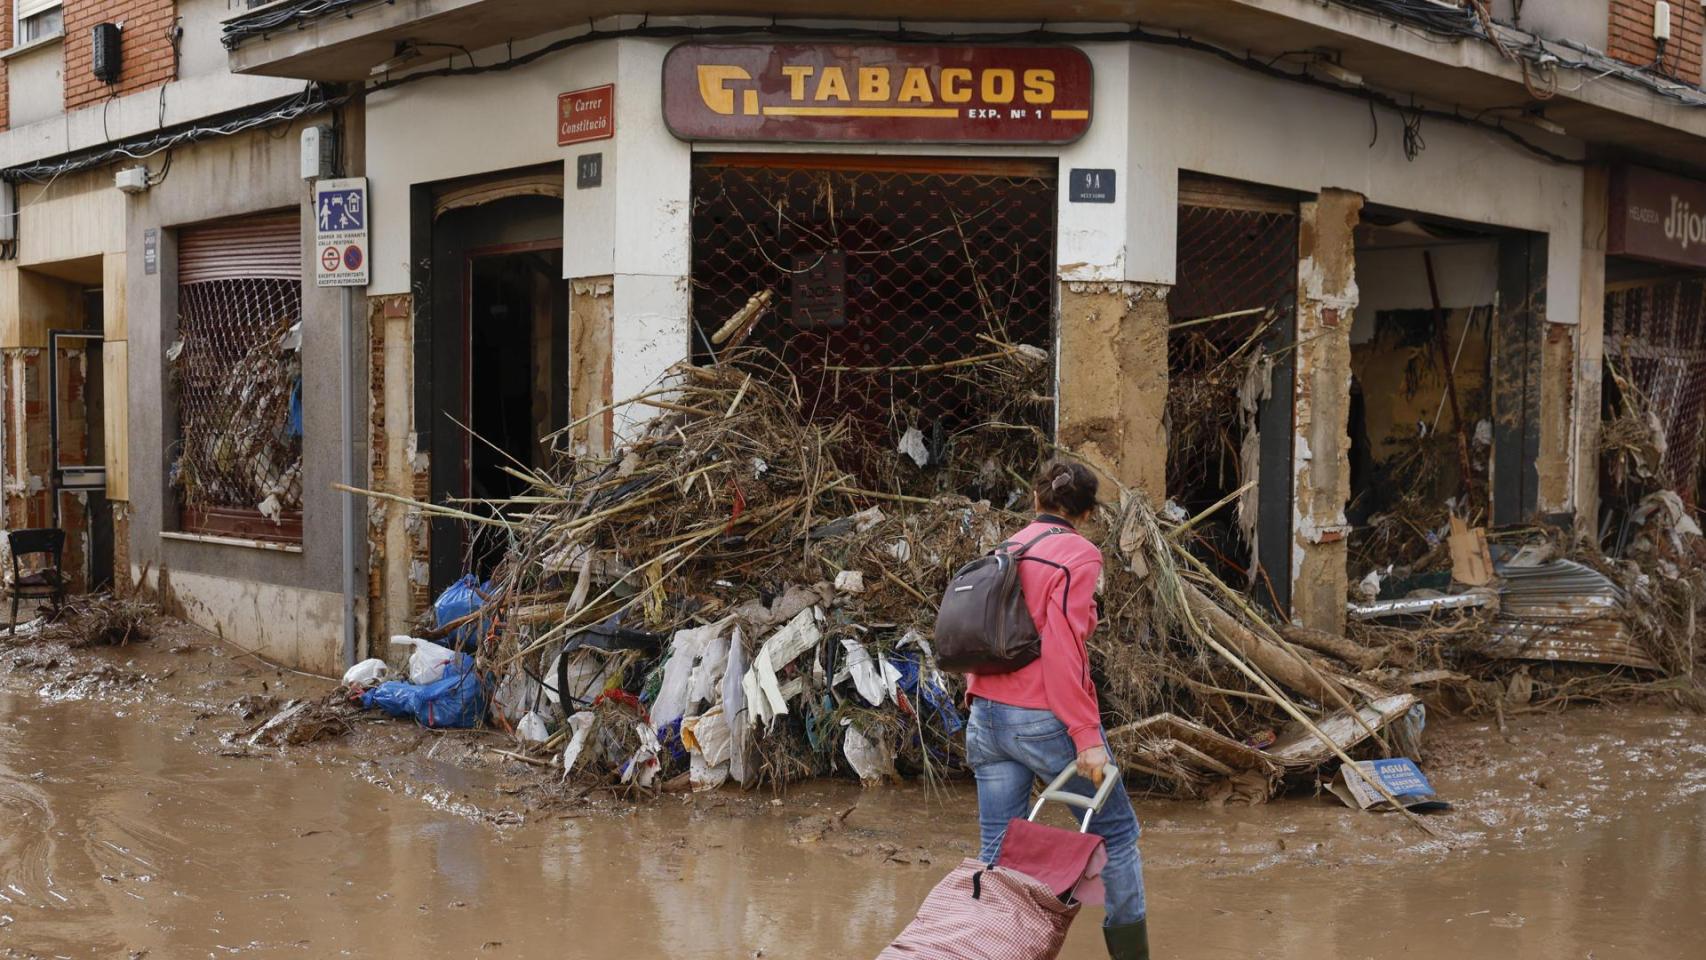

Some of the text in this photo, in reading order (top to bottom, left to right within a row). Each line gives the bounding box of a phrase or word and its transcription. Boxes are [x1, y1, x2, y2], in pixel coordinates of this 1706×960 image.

[782, 66, 1055, 103] TABACOS
[575, 98, 602, 112] Carrer
[968, 108, 1001, 118] EXP.
[1035, 108, 1042, 118] 1
[561, 116, 607, 135] Constitució
[1085, 173, 1100, 189] 9 A
[1381, 764, 1411, 774] AGUA
